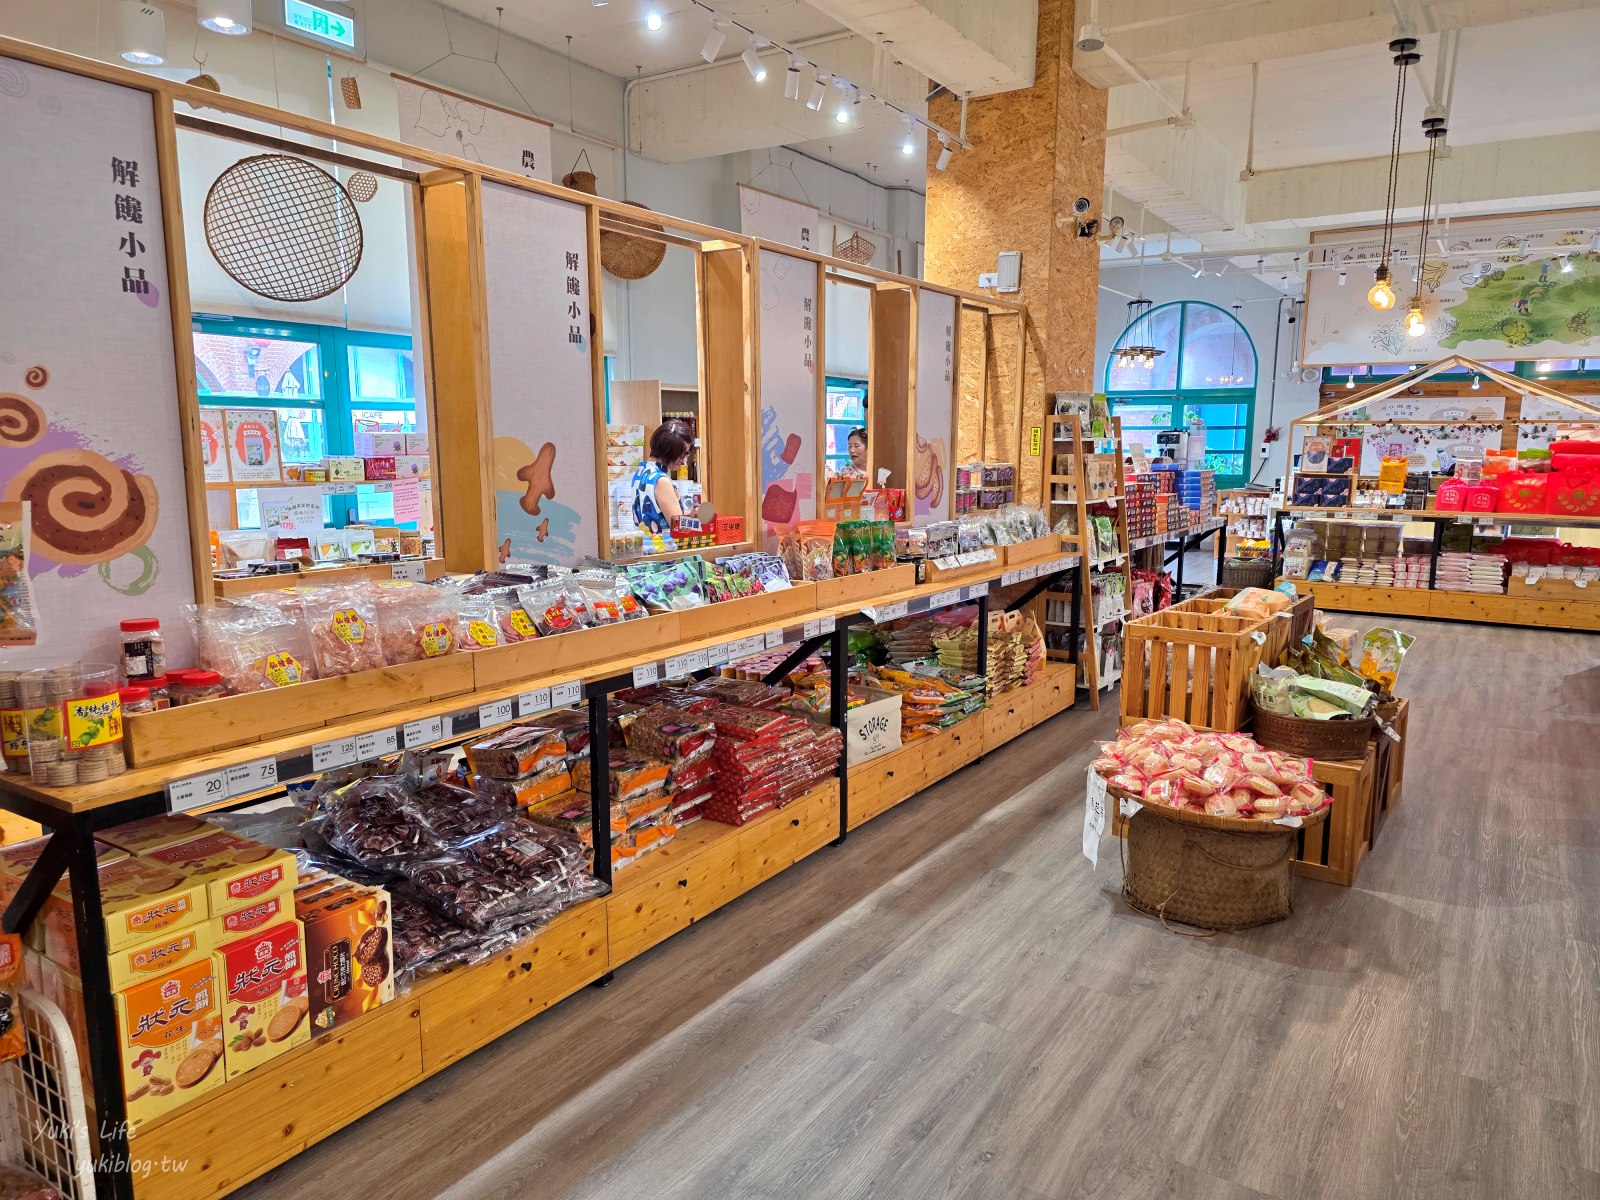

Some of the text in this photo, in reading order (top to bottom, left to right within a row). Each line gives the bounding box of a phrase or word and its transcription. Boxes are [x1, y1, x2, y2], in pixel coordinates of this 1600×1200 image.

[111, 156, 150, 295] 解饞小品
[565, 250, 582, 344] 解饞小品
[646, 666, 657, 676] 110
[567, 685, 580, 696] 110
[535, 693, 548, 704] 110
[496, 704, 511, 715] 100
[431, 723, 440, 732] 85
[858, 716, 889, 741] STORAGE
[386, 735, 396, 744] 85
[341, 743, 355, 753] 125
[260, 764, 275, 777] 75
[206, 779, 222, 793] 20
[331, 945, 340, 998] CRUNCHOCO
